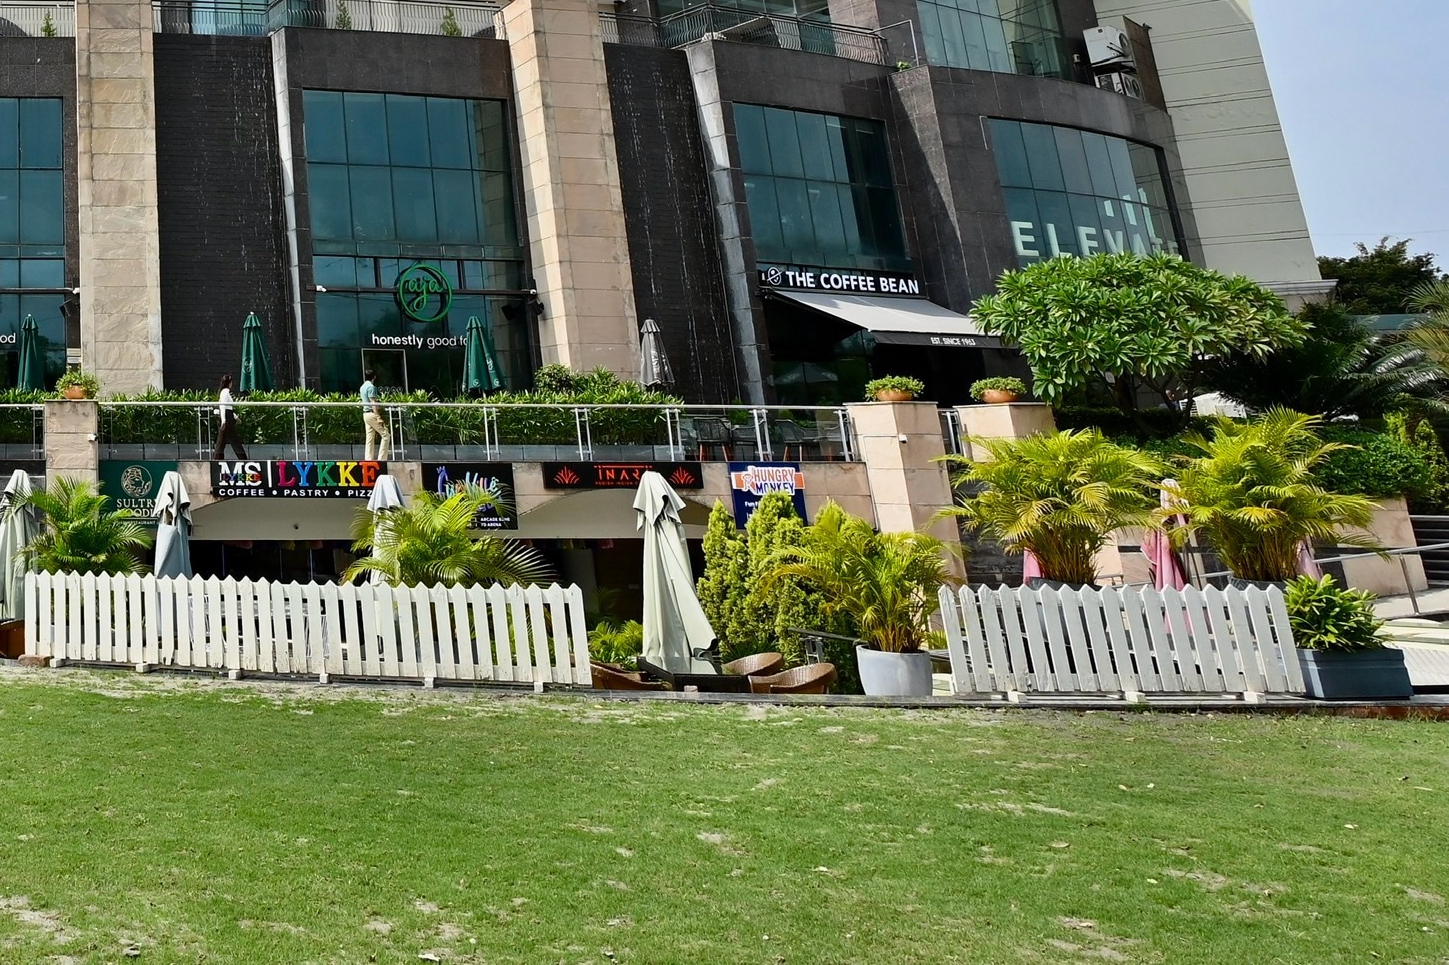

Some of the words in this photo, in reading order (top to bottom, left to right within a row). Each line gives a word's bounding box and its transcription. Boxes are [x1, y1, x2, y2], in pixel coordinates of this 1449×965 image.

[786, 271, 816, 288] THE
[820, 273, 876, 291] COFFEE
[881, 279, 920, 295] BEAN
[408, 277, 444, 312] aja
[372, 333, 424, 349] honestly
[427, 336, 457, 349] good
[218, 461, 262, 486] MS
[276, 461, 380, 487] LYKKE
[598, 468, 640, 481] INAR
[753, 469, 794, 482] HUNGRY
[218, 488, 265, 497] COFFEE
[284, 489, 329, 497] PASTRY
[348, 489, 373, 498] PIZZ
[116, 498, 156, 508] SULTR
